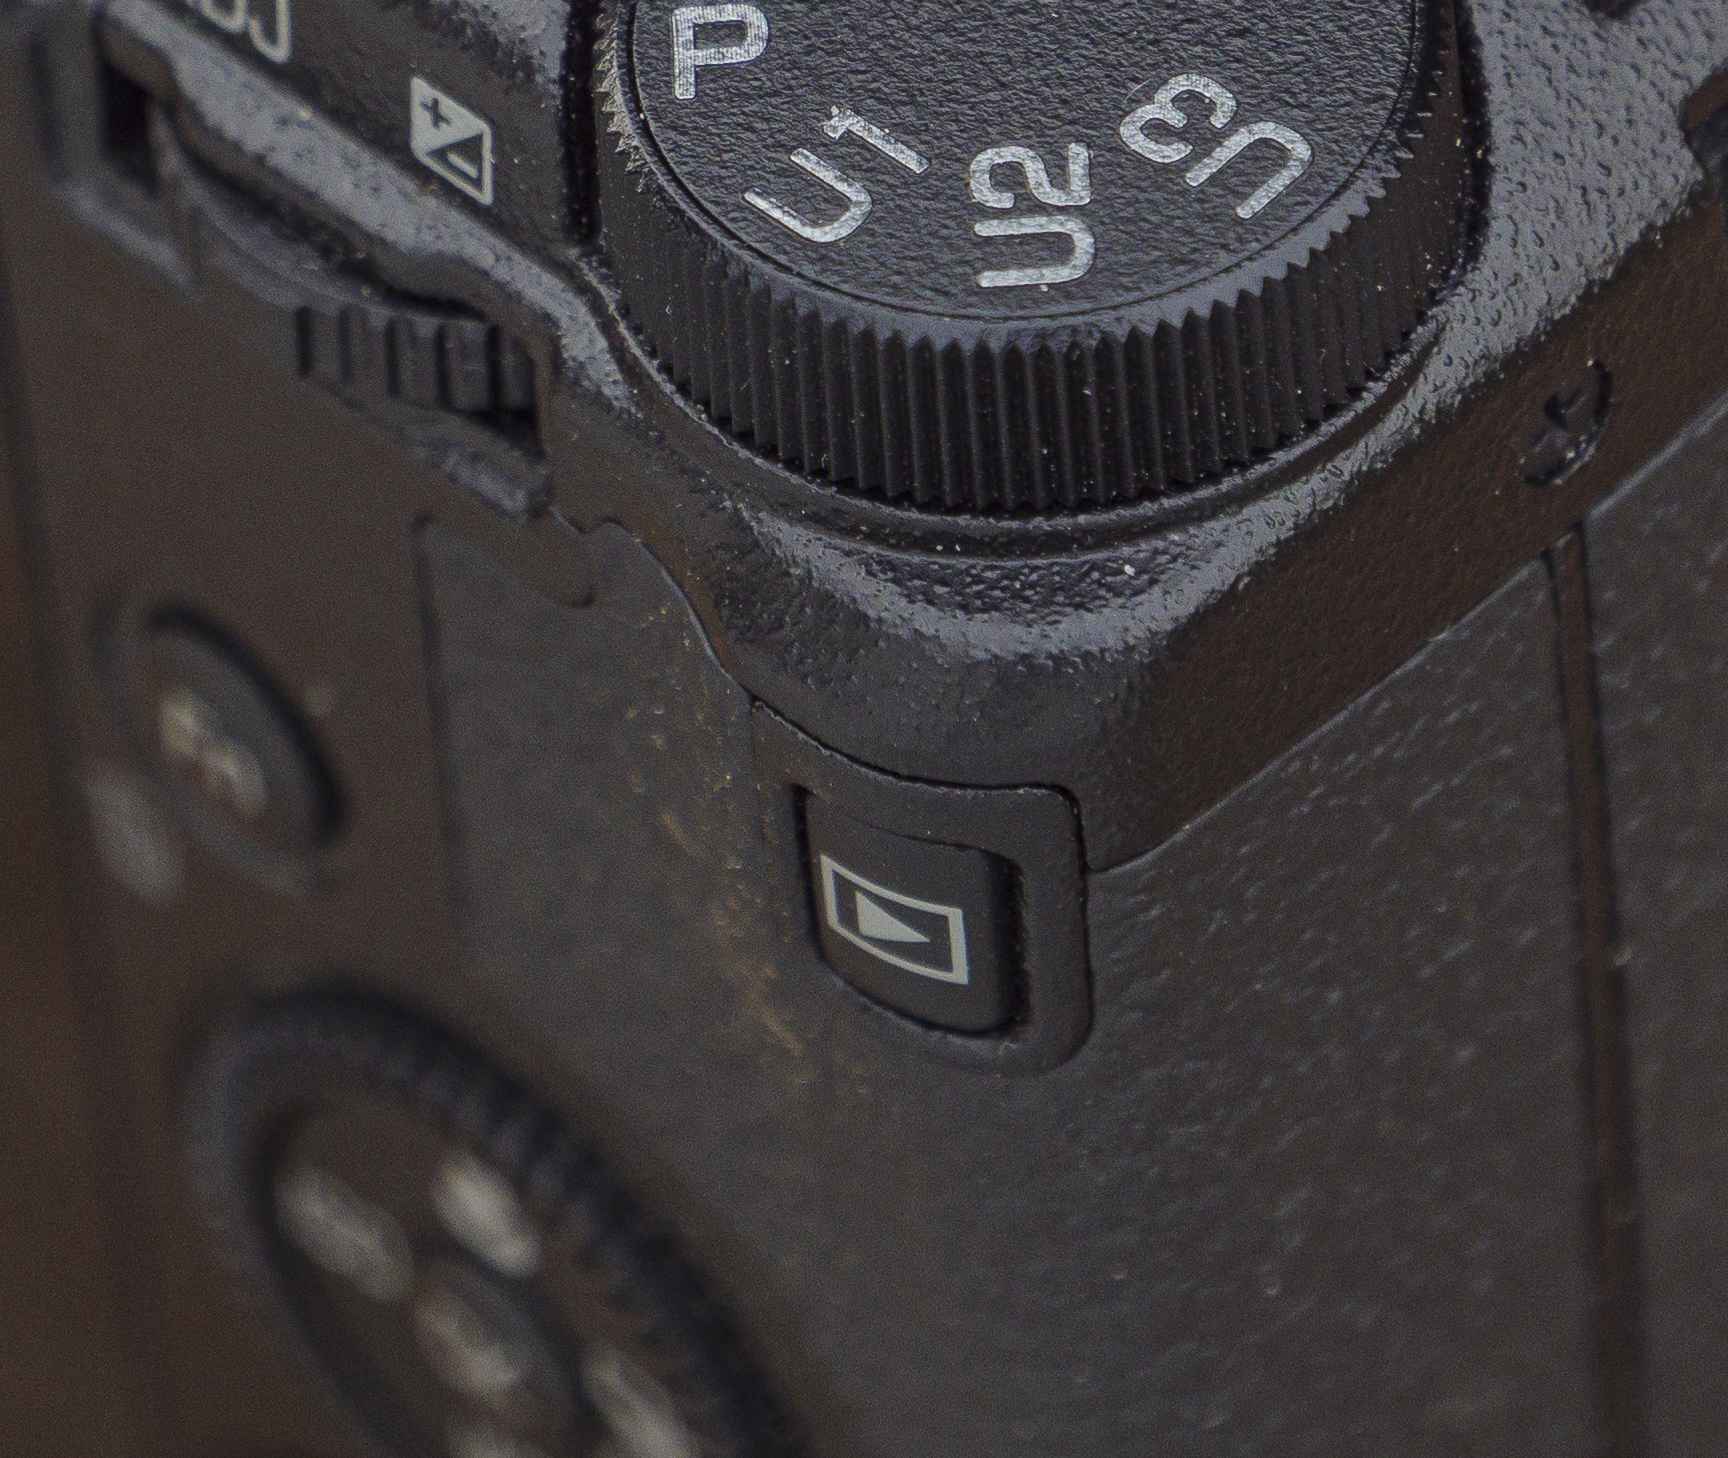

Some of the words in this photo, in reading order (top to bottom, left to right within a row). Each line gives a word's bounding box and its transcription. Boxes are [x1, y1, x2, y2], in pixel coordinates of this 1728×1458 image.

[672, 3, 769, 99] P
[745, 106, 931, 243] U1
[970, 142, 1095, 288] U2
[1118, 73, 1312, 219] U3
